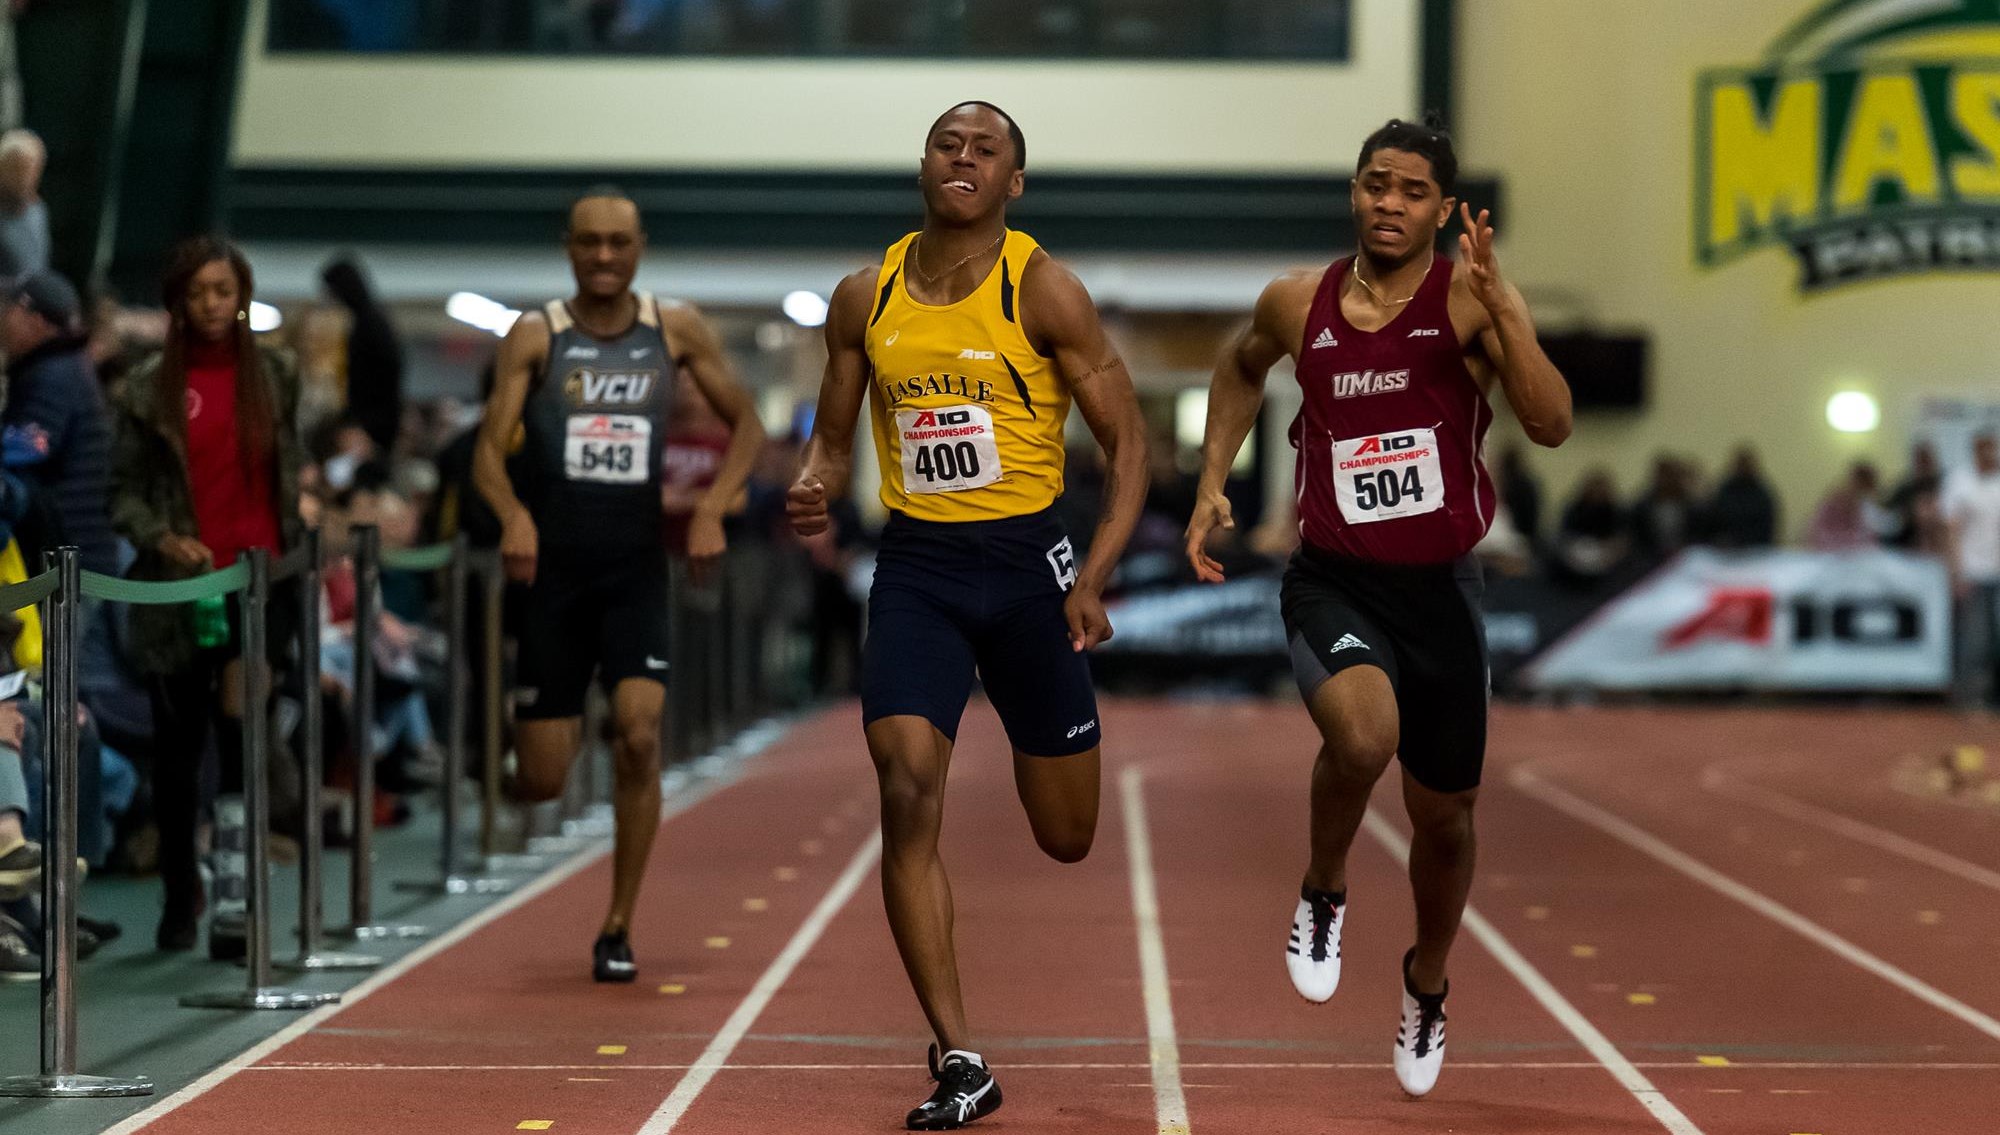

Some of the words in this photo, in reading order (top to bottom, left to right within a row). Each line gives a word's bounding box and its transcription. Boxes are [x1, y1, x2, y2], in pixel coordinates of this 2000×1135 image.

[1312, 339, 1339, 349] adidas
[1407, 329, 1440, 338] A10
[956, 348, 996, 360] A10
[581, 368, 652, 403] VCU
[886, 373, 995, 404] LASALLE
[912, 410, 970, 428] A10
[903, 425, 984, 441] CHAMPIONSHIPS
[1353, 435, 1416, 456] A10
[581, 444, 633, 473] 543
[915, 441, 980, 482] 400
[1339, 448, 1430, 470] CHAMPIONSHIPS
[1353, 465, 1424, 511] 504
[1656, 584, 1922, 652] A10
[1078, 719, 1096, 734] asics
